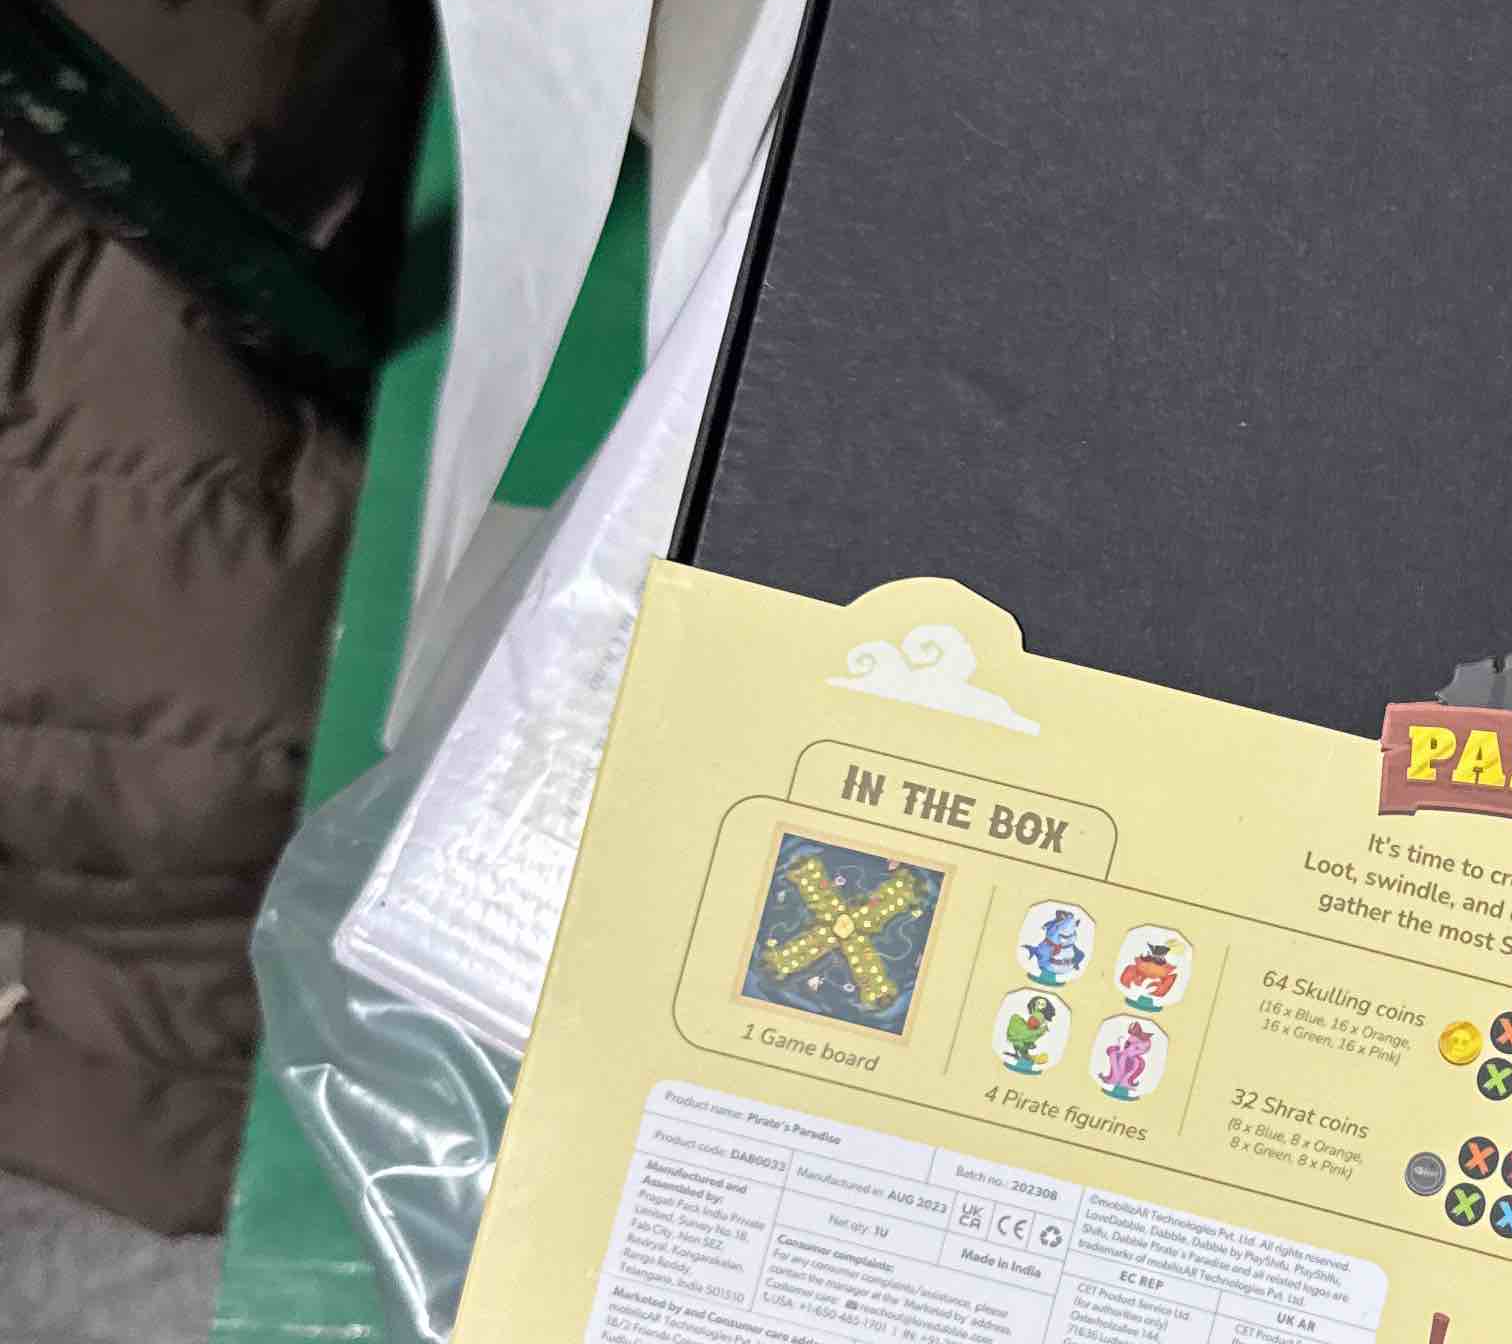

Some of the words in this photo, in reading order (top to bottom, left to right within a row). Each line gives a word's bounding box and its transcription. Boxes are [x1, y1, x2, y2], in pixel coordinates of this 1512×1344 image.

[839, 763, 887, 808] IN
[900, 779, 978, 831] THE
[987, 802, 1070, 855] BOX
[1302, 849, 1359, 886] Loot,
[1363, 870, 1456, 911] swindle,
[1461, 895, 1506, 920] and
[1367, 832, 1402, 860] It's
[1406, 843, 1457, 874] time
[1460, 857, 1485, 881] to
[1317, 892, 1394, 924] gather
[1396, 908, 1434, 935] the
[1437, 923, 1497, 952] most
[1261, 969, 1290, 992] 64
[1290, 977, 1373, 1018] Skulling
[1374, 1003, 1427, 1028] coins
[739, 1022, 756, 1042] 1
[759, 1026, 818, 1058] Game
[818, 1041, 882, 1073] board
[983, 1084, 1000, 1104] 4
[1000, 1087, 1061, 1120] Pirate
[1063, 1104, 1149, 1142] figurines
[1230, 1087, 1260, 1111] 32
[1260, 1095, 1317, 1126] Shrat
[1318, 1114, 1370, 1140] coins
